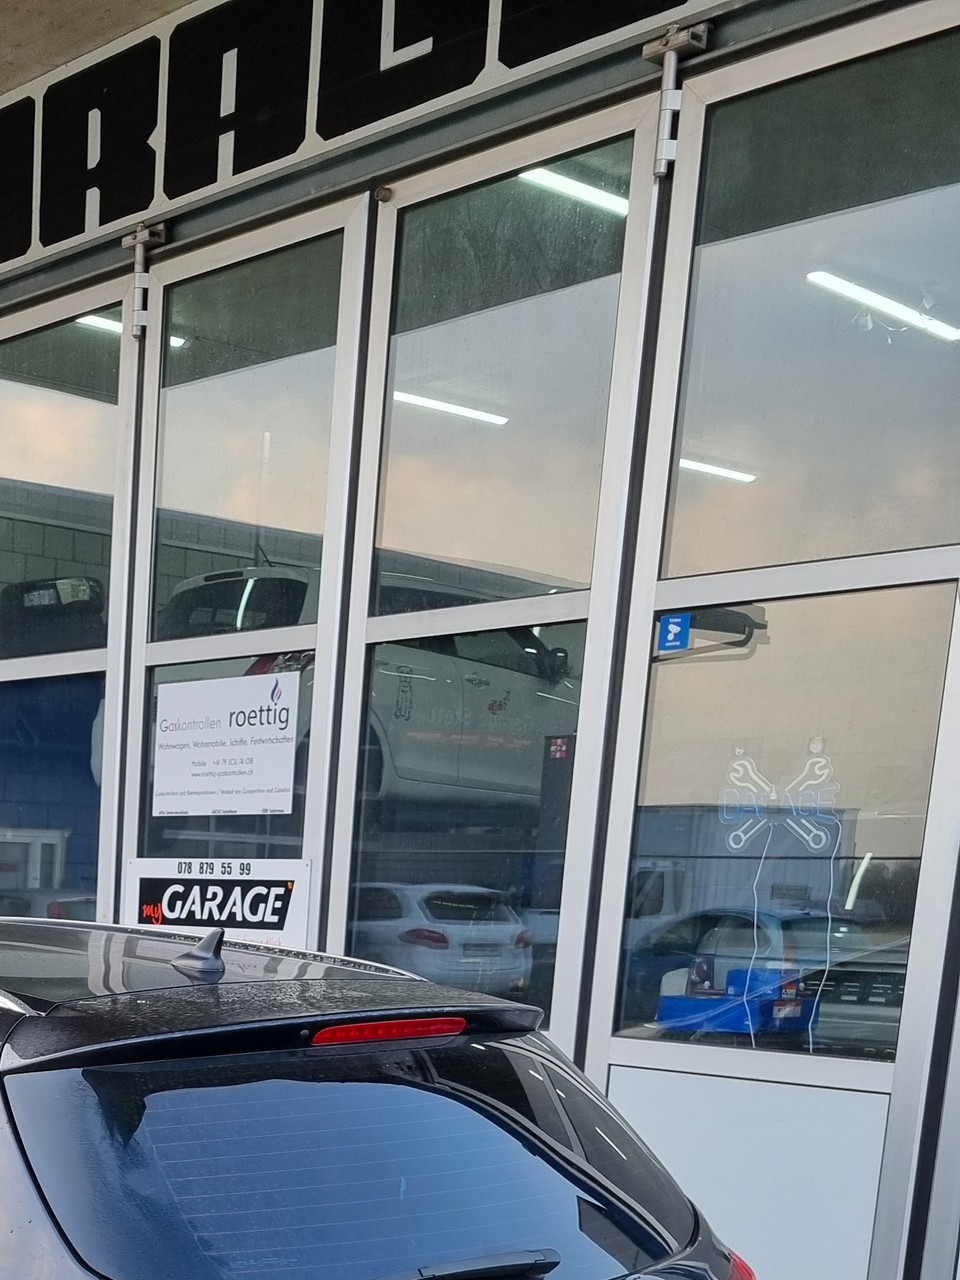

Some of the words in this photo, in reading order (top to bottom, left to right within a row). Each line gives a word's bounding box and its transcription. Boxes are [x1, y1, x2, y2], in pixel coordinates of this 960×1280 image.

[159, 716, 222, 732] Gaskontrollen
[228, 702, 290, 731] roettig
[177, 861, 192, 874] 078
[199, 862, 215, 875] 879
[221, 862, 233, 875] 55
[239, 862, 252, 876] 99
[142, 903, 163, 926] my
[161, 883, 286, 923] GARAGE
